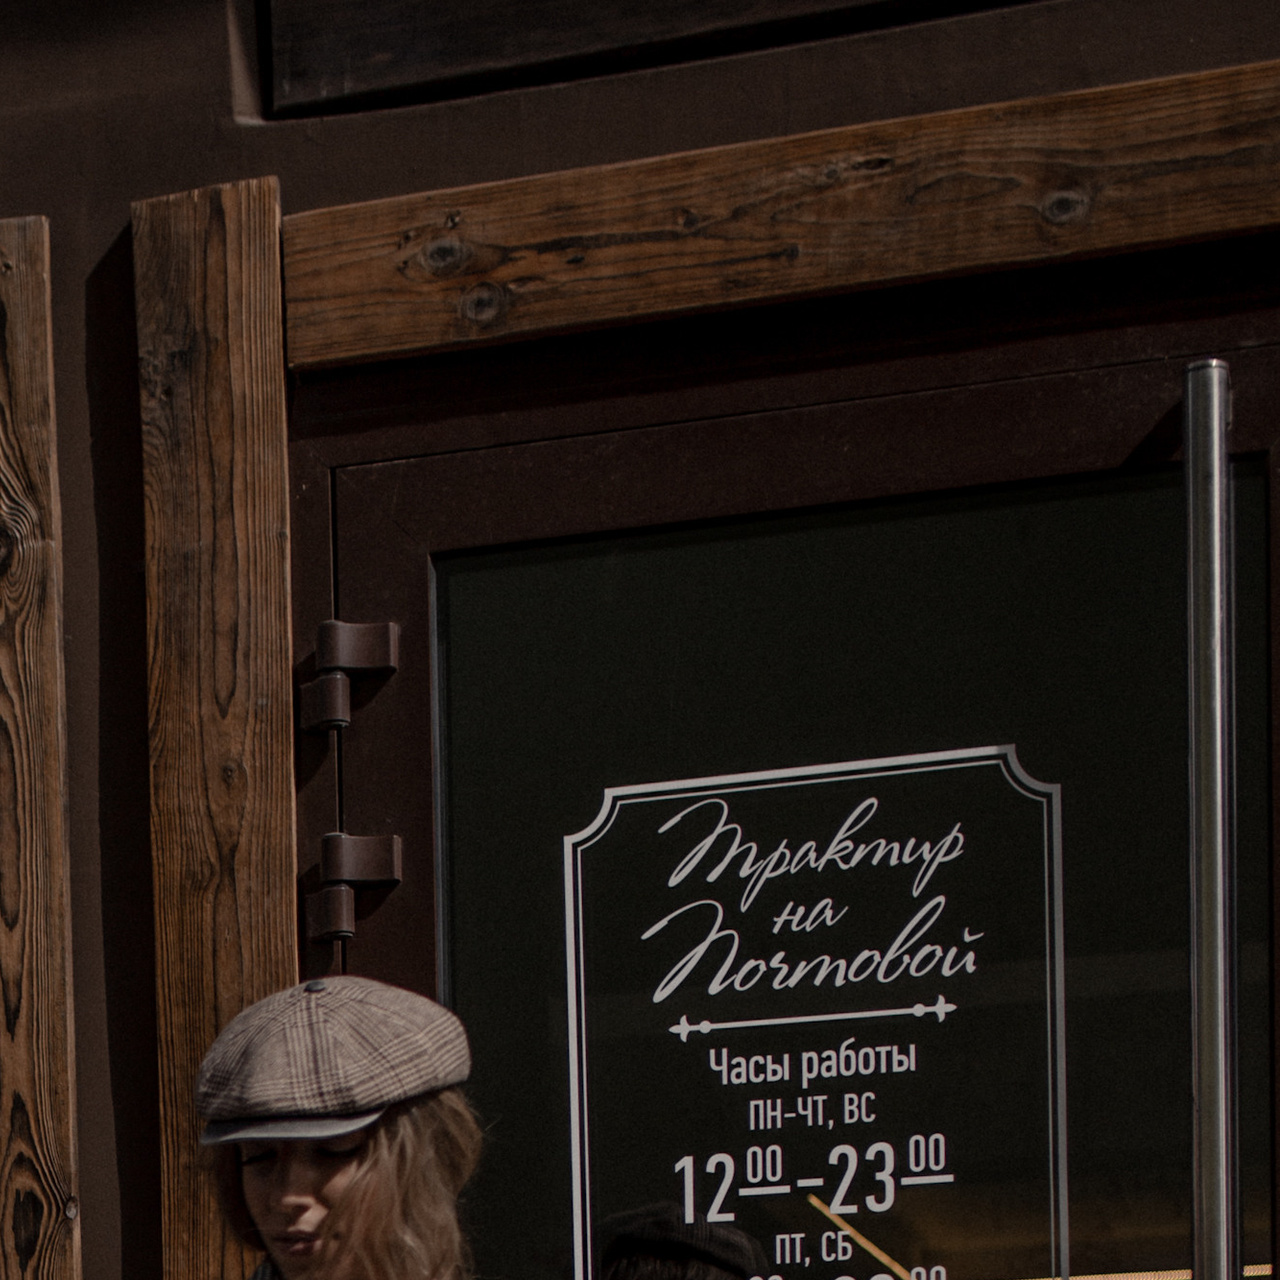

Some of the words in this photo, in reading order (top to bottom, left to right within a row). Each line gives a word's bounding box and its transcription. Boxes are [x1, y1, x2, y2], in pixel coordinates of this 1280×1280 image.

[658, 797, 965, 913] Трактир
[773, 898, 849, 935] на
[641, 895, 985, 1003] Почтовой
[710, 1048, 790, 1086] Часы
[801, 1037, 917, 1090] работы
[844, 1092, 876, 1124] ВС
[776, 1232, 811, 1269] ПТ,
[822, 1231, 854, 1263] СБ
